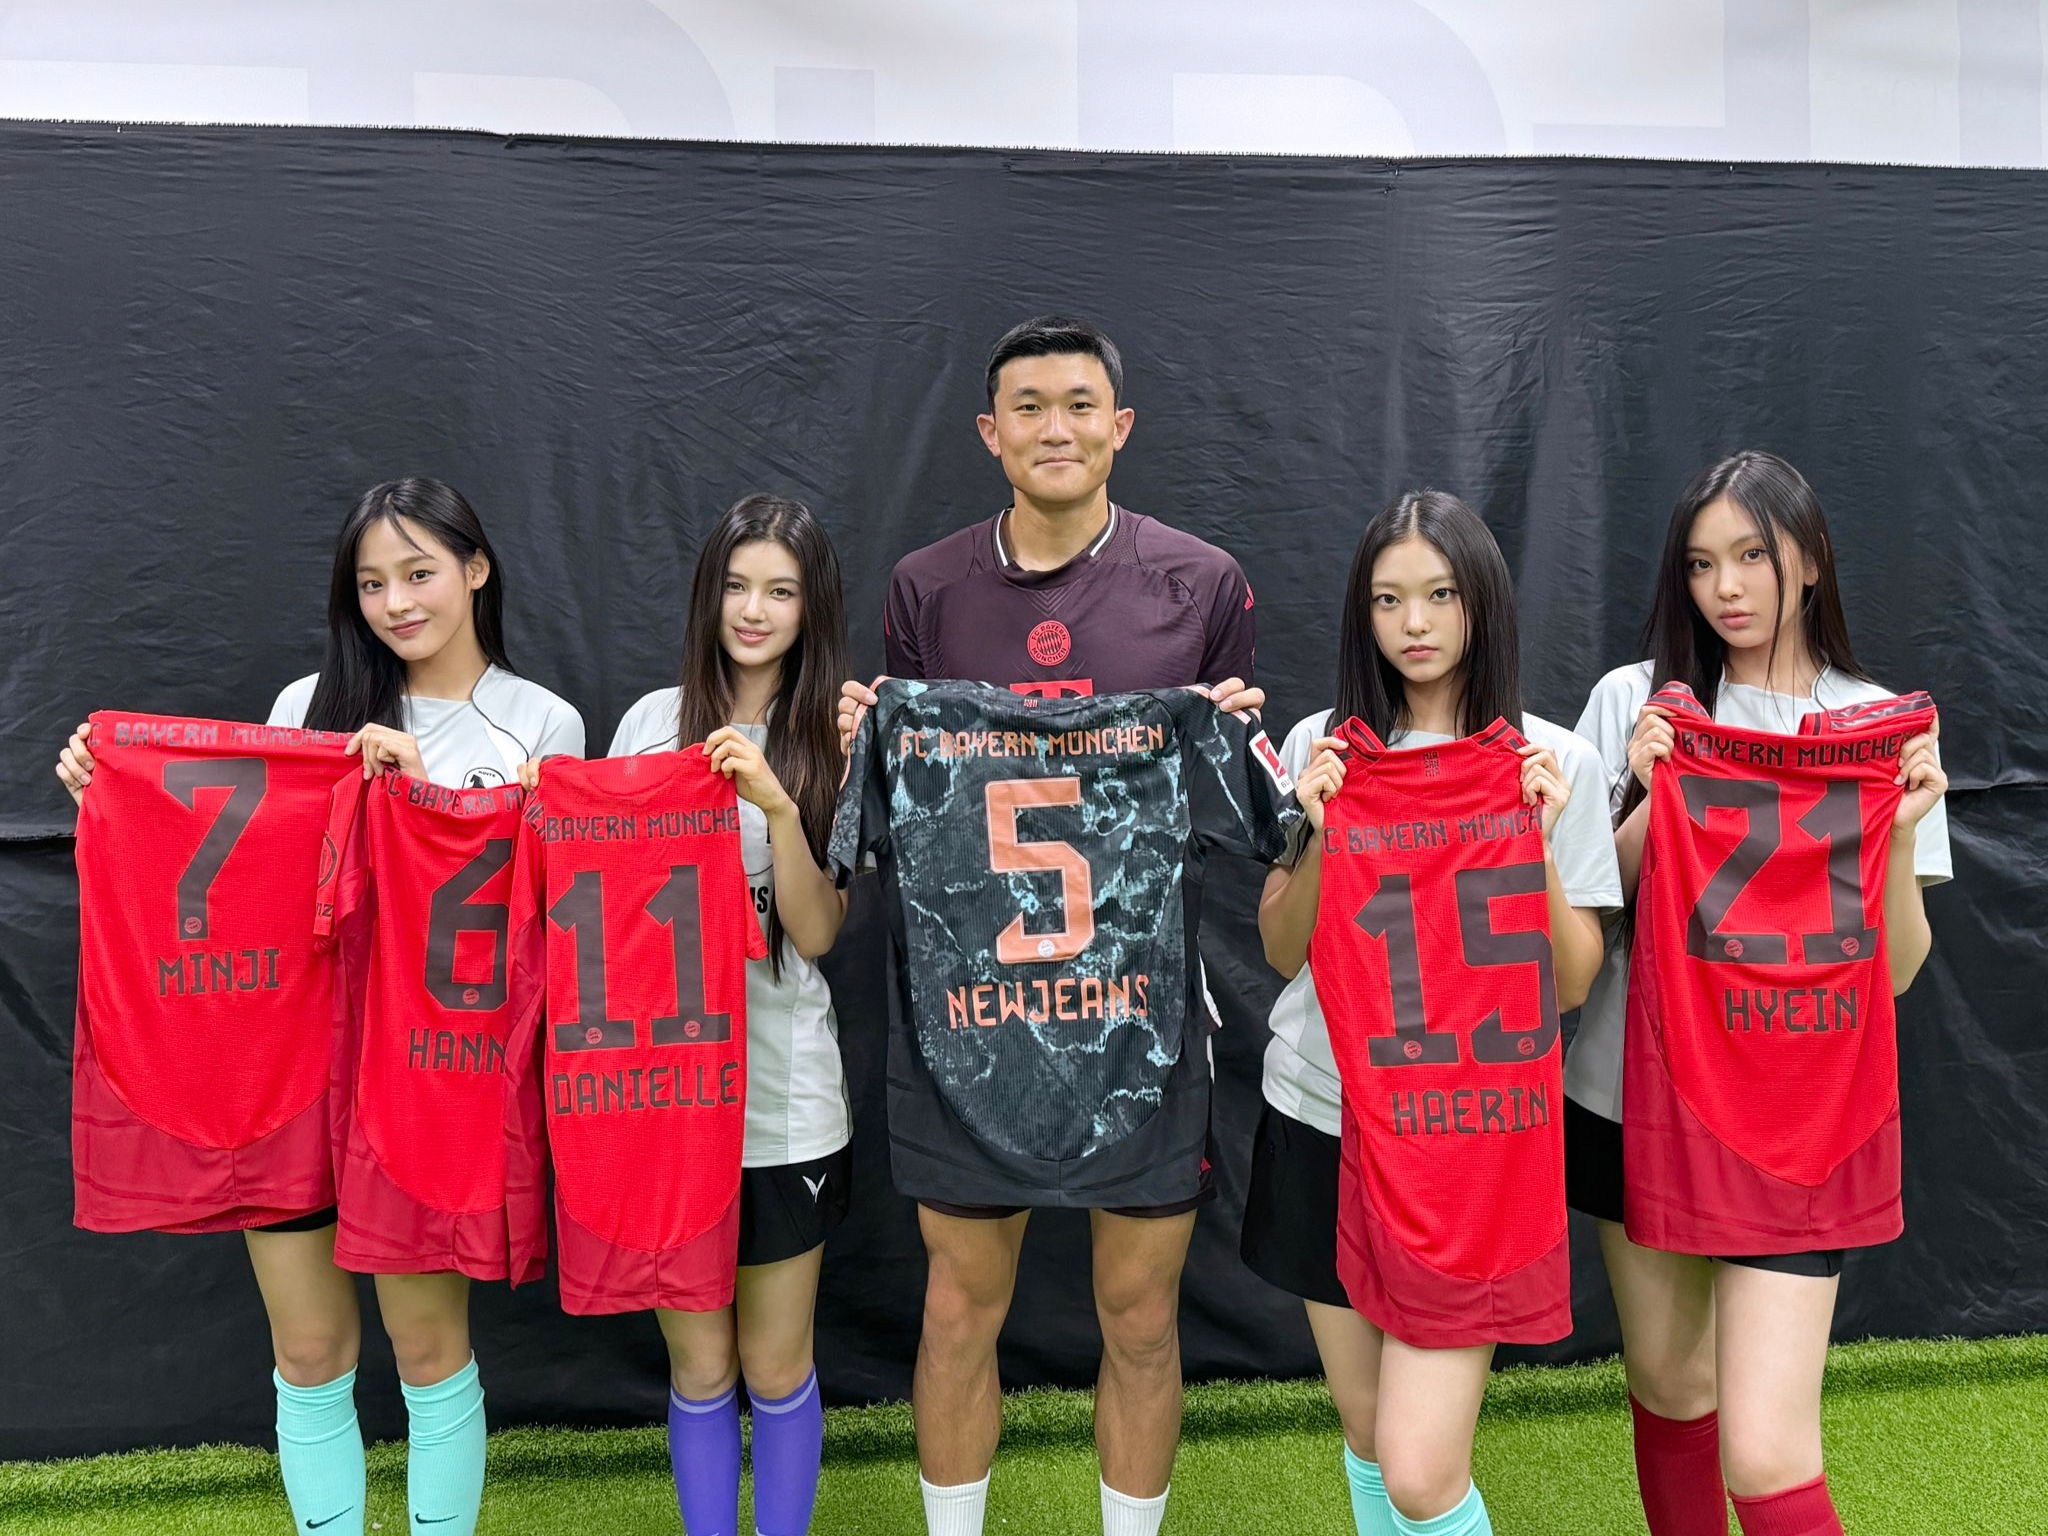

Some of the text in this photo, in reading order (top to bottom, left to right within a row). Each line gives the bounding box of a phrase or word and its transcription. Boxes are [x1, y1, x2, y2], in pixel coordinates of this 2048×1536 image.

[114, 721, 218, 748] BAYERN
[901, 723, 1164, 758] FC BAYERN MÜNCHEN
[1681, 731, 1784, 767] BAYERN
[408, 780, 496, 816] BAYERN
[164, 757, 267, 940] 7
[546, 815, 636, 843] BAYERN
[1347, 819, 1448, 854] BAYERN
[985, 776, 1095, 964] 5
[1679, 774, 1878, 965] 21
[425, 838, 513, 1012] 6
[157, 948, 281, 997] MINJI
[547, 865, 733, 1052] 11
[1353, 862, 1561, 1067] 15
[946, 974, 1150, 1029] NEWJEANS
[1725, 987, 1857, 1033] HYEIN
[553, 1062, 740, 1115] DANIELLE
[1392, 1086, 1549, 1137] HAERIN
